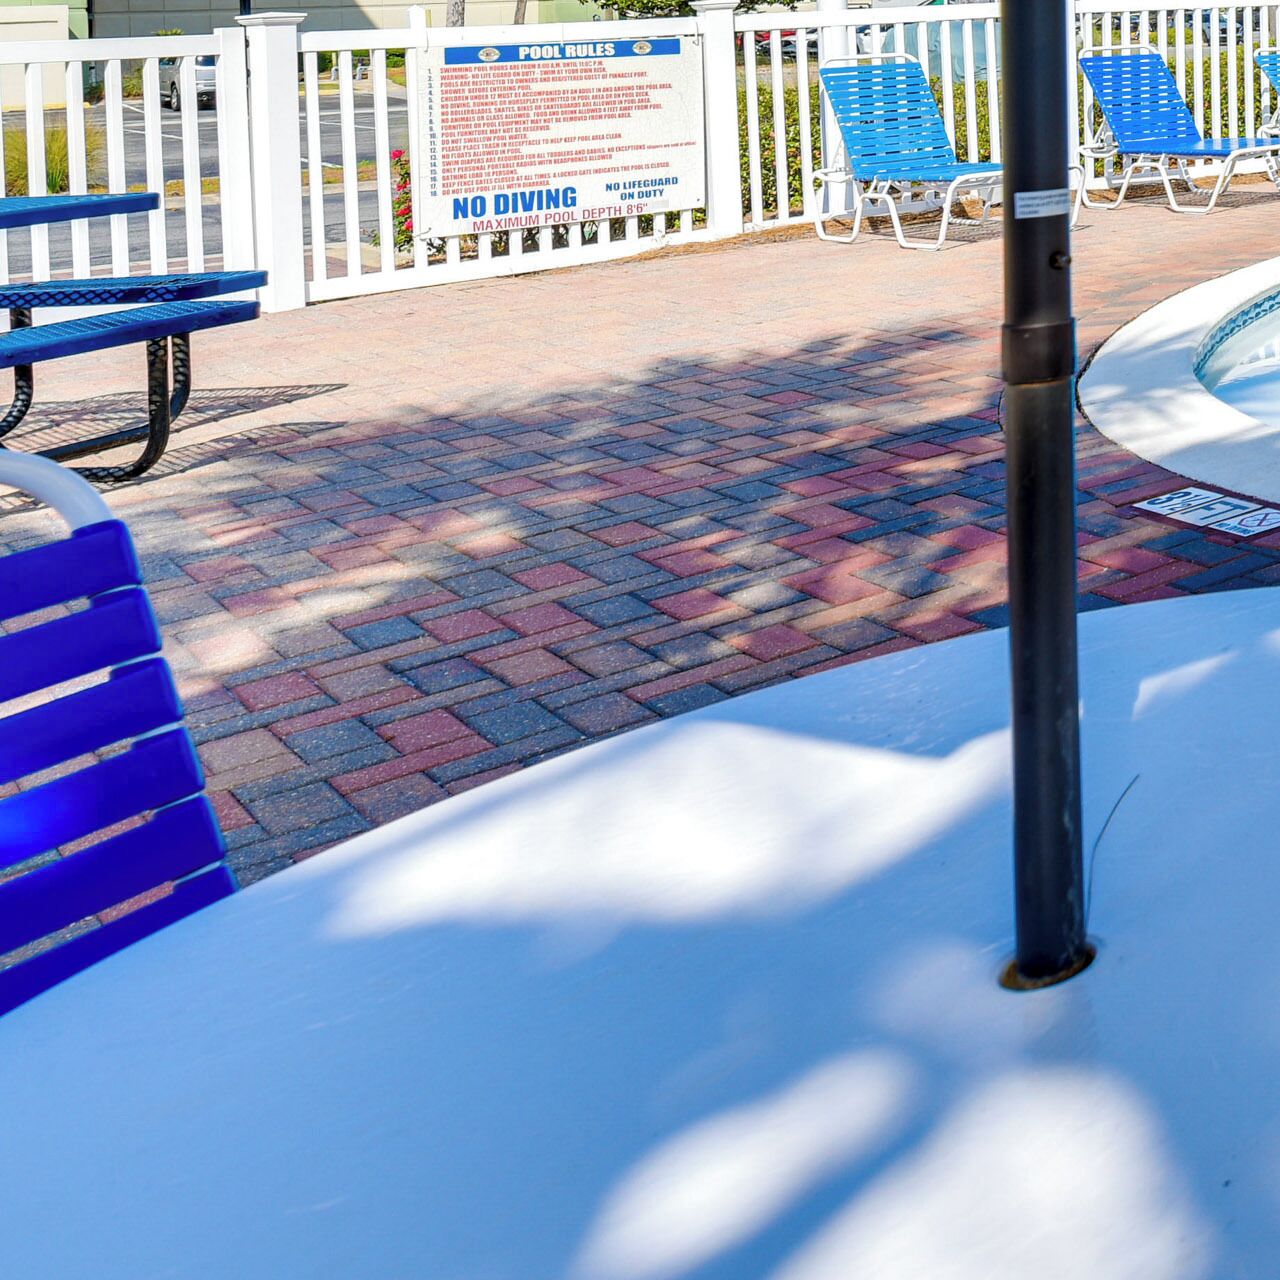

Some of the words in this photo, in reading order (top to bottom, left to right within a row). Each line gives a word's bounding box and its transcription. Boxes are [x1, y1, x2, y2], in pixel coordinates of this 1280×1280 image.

[519, 46, 562, 60] POOL
[565, 43, 615, 57] RULES
[606, 182, 620, 191] NO
[623, 177, 679, 190] LIFEGUARD
[453, 195, 487, 220] NO
[494, 187, 577, 216] DIVING
[620, 191, 635, 201] ON
[637, 189, 664, 200] DUTY
[473, 214, 540, 232] MAXIMUM
[545, 211, 578, 225] POOL
[582, 206, 622, 220] DEPTH
[1182, 500, 1250, 521] FT
